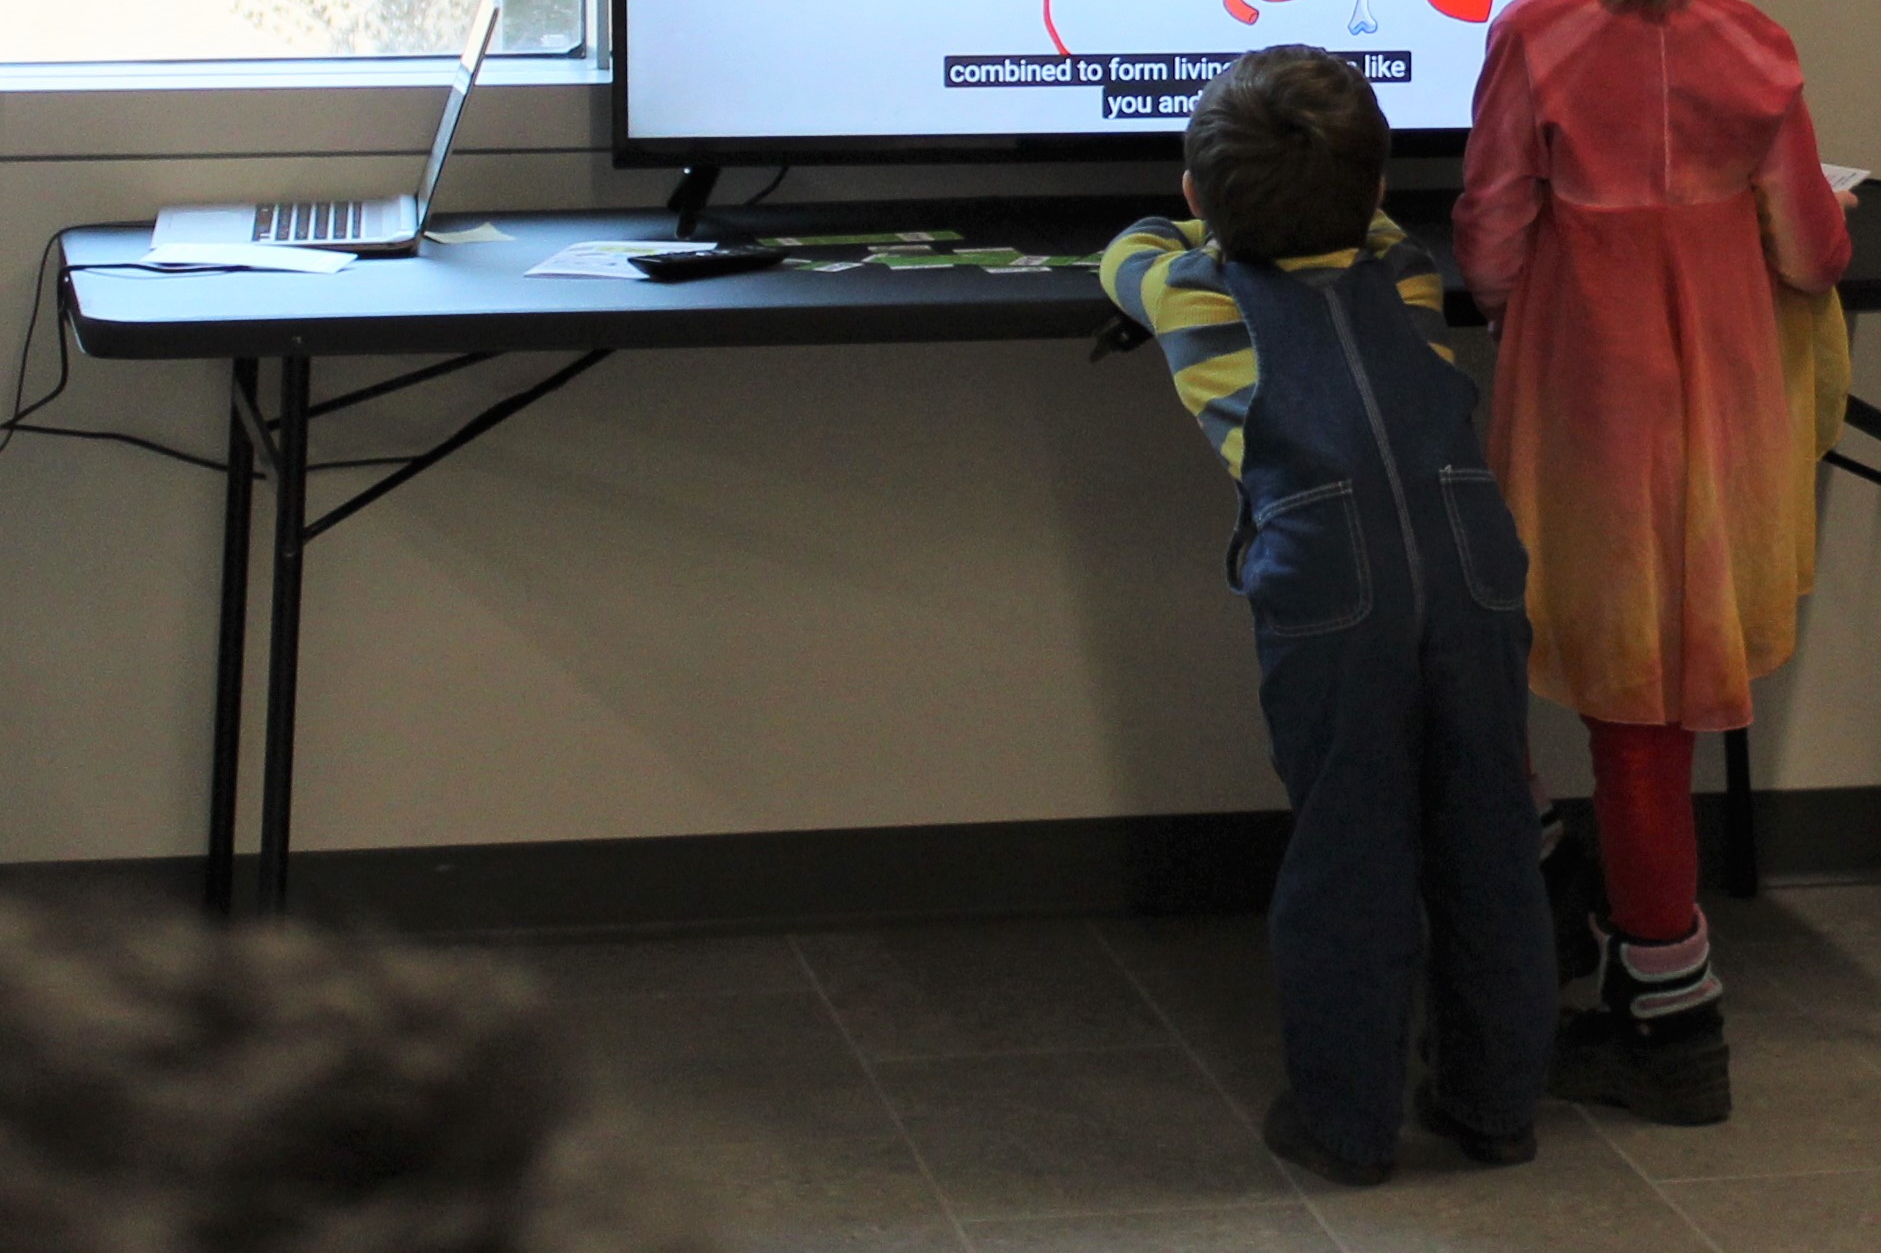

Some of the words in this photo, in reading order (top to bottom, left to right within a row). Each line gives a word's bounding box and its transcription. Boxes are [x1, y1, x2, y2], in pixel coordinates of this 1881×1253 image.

[949, 58, 1071, 83] combined
[1077, 60, 1103, 82] to
[1108, 57, 1168, 81] form
[1174, 56, 1231, 80] livin
[1364, 54, 1406, 78] like
[1108, 96, 1152, 119] you
